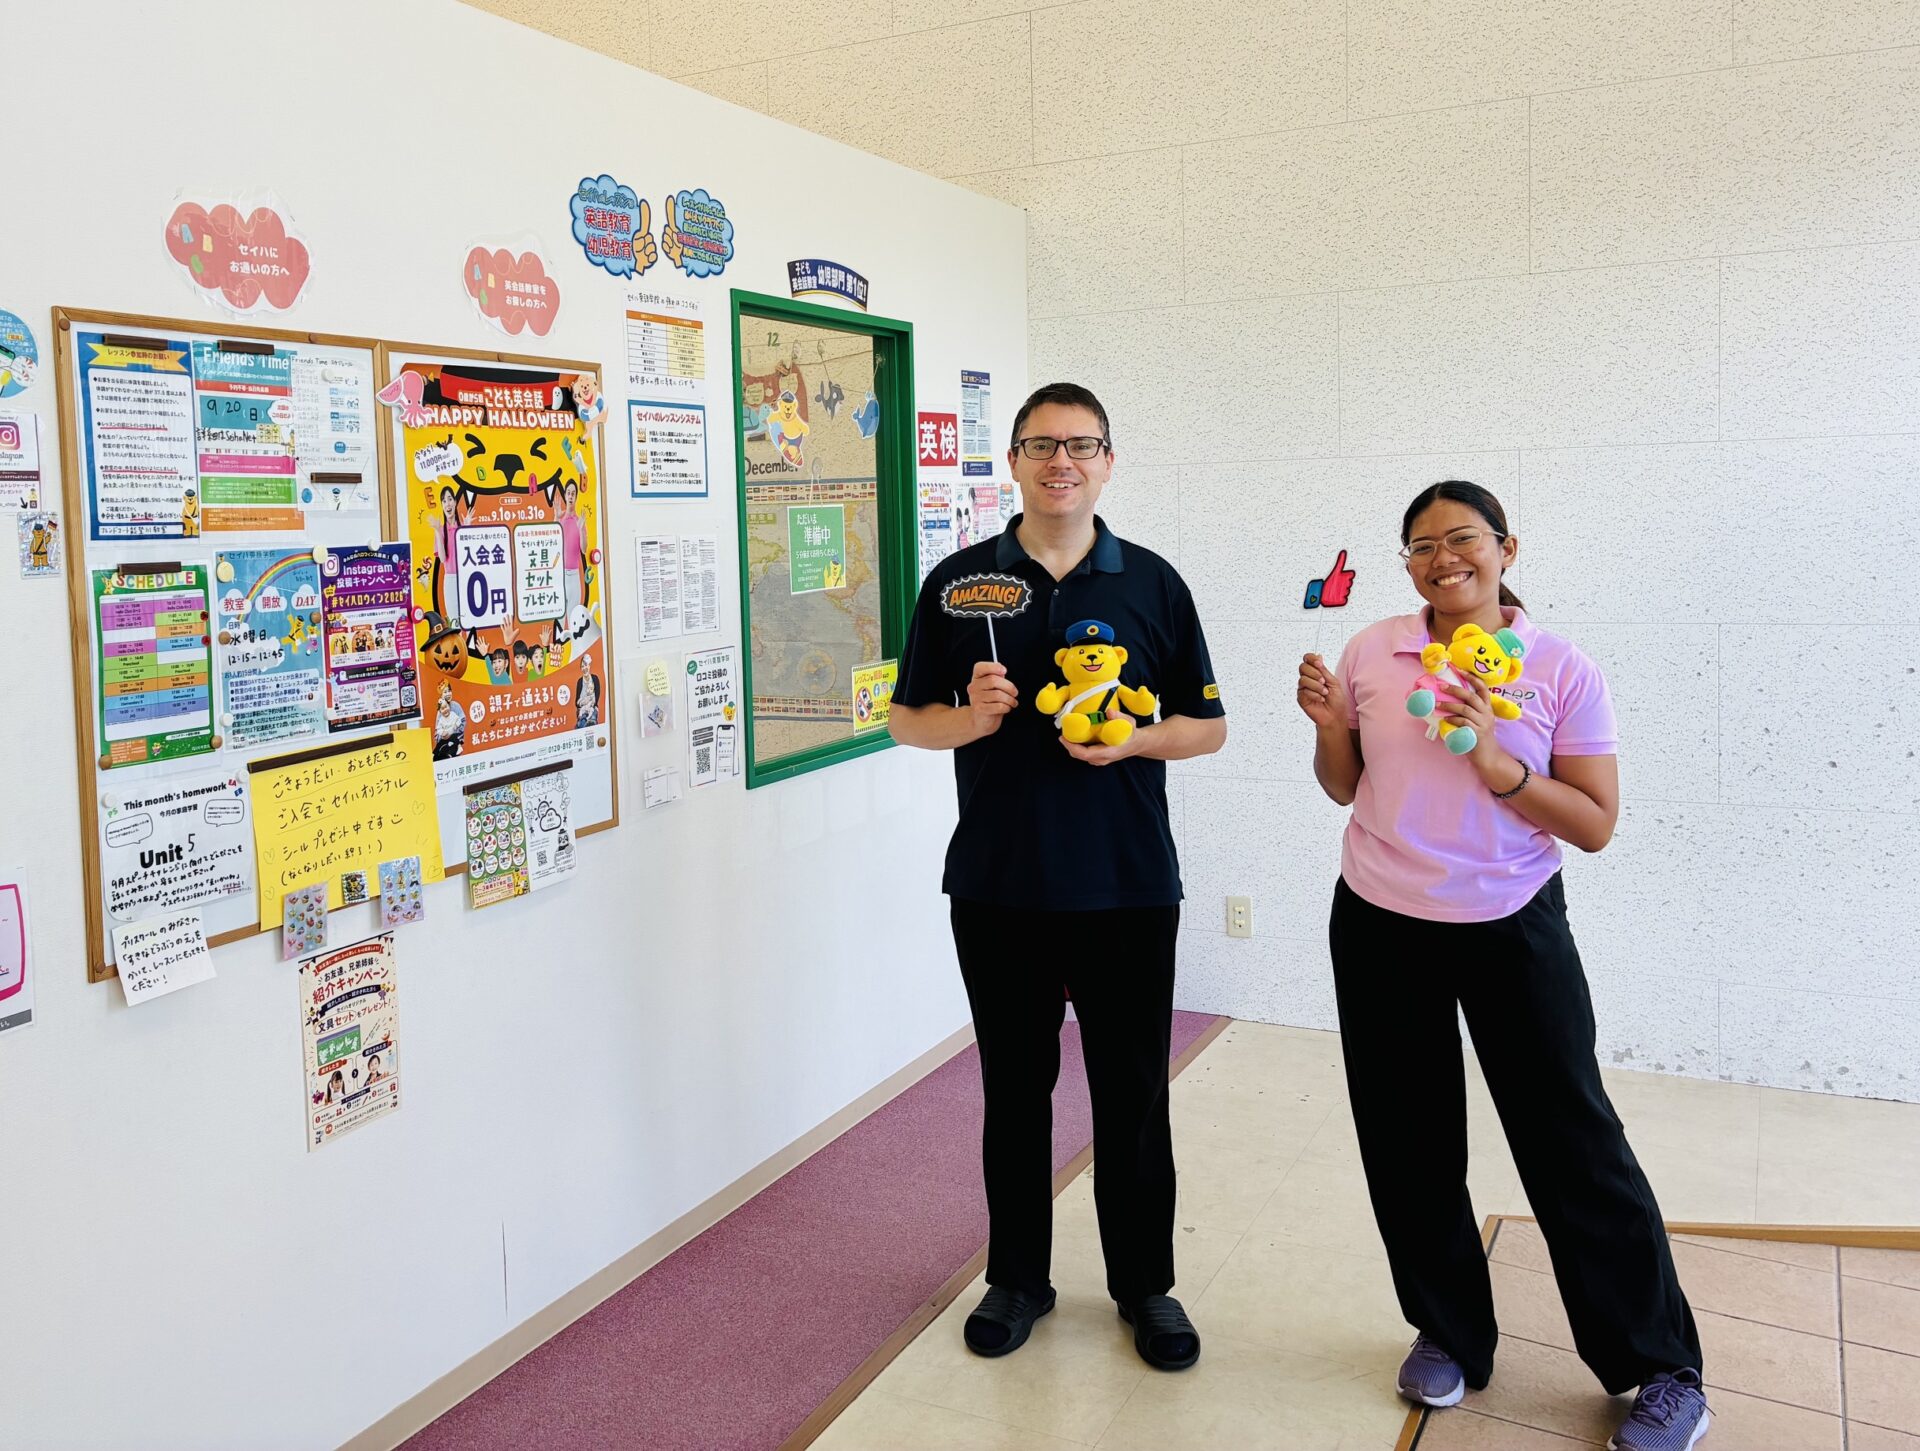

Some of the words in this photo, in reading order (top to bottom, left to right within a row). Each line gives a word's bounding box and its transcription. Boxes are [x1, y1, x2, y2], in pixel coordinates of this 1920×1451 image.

[584, 207, 631, 234] 英語教育
[238, 243, 279, 258] セイハに
[587, 234, 633, 261] 幼児教育
[229, 261, 290, 276] お通いの方へ
[795, 262, 811, 276] 子ども
[505, 280, 546, 296] 英会話教室を
[792, 275, 817, 291] 英会話教室
[817, 265, 846, 291] 幼児部門
[846, 273, 867, 302] 第1位!
[505, 295, 547, 309] お探しの方へ
[767, 332, 780, 347] 12
[107, 349, 170, 360] レッスン参加時のお願い
[483, 388, 544, 410] こども英会話
[429, 405, 484, 427] HAPPY
[489, 409, 575, 430] HALLOWEEN
[636, 410, 702, 425] セイハのレッスンシステム
[919, 420, 957, 461] 英検
[804, 525, 831, 547] 準備中
[462, 543, 506, 567] 入会金
[528, 549, 550, 568] 文具
[343, 564, 393, 576] Instagram
[525, 570, 553, 588] セット
[116, 571, 194, 588] SCHEDULE
[336, 574, 400, 589] 投稿キャンペーン
[224, 598, 245, 612] 教室
[262, 596, 281, 609] 開放
[295, 595, 317, 608] DAY
[467, 571, 507, 618] 0円
[523, 591, 560, 608] プレゼント
[949, 584, 1022, 608] AMAZING!
[229, 629, 267, 646] 水曜日
[696, 668, 728, 681] 口コミ投稿の
[694, 680, 730, 696] ご協力よろしく
[488, 686, 554, 715] 親子で通える!
[697, 694, 729, 709] お願いします
[471, 716, 567, 746] 私たちにおまかせください!
[124, 799, 143, 812] This
[144, 793, 181, 807] month's
[182, 781, 227, 799] homework
[139, 843, 184, 869] Unit
[188, 833, 196, 853] 5
[323, 957, 375, 984] お友達、兄弟姉妹
[312, 967, 390, 1006] 紹介キャンペーン
[317, 999, 391, 1034] 文具セットをプレゼント!
